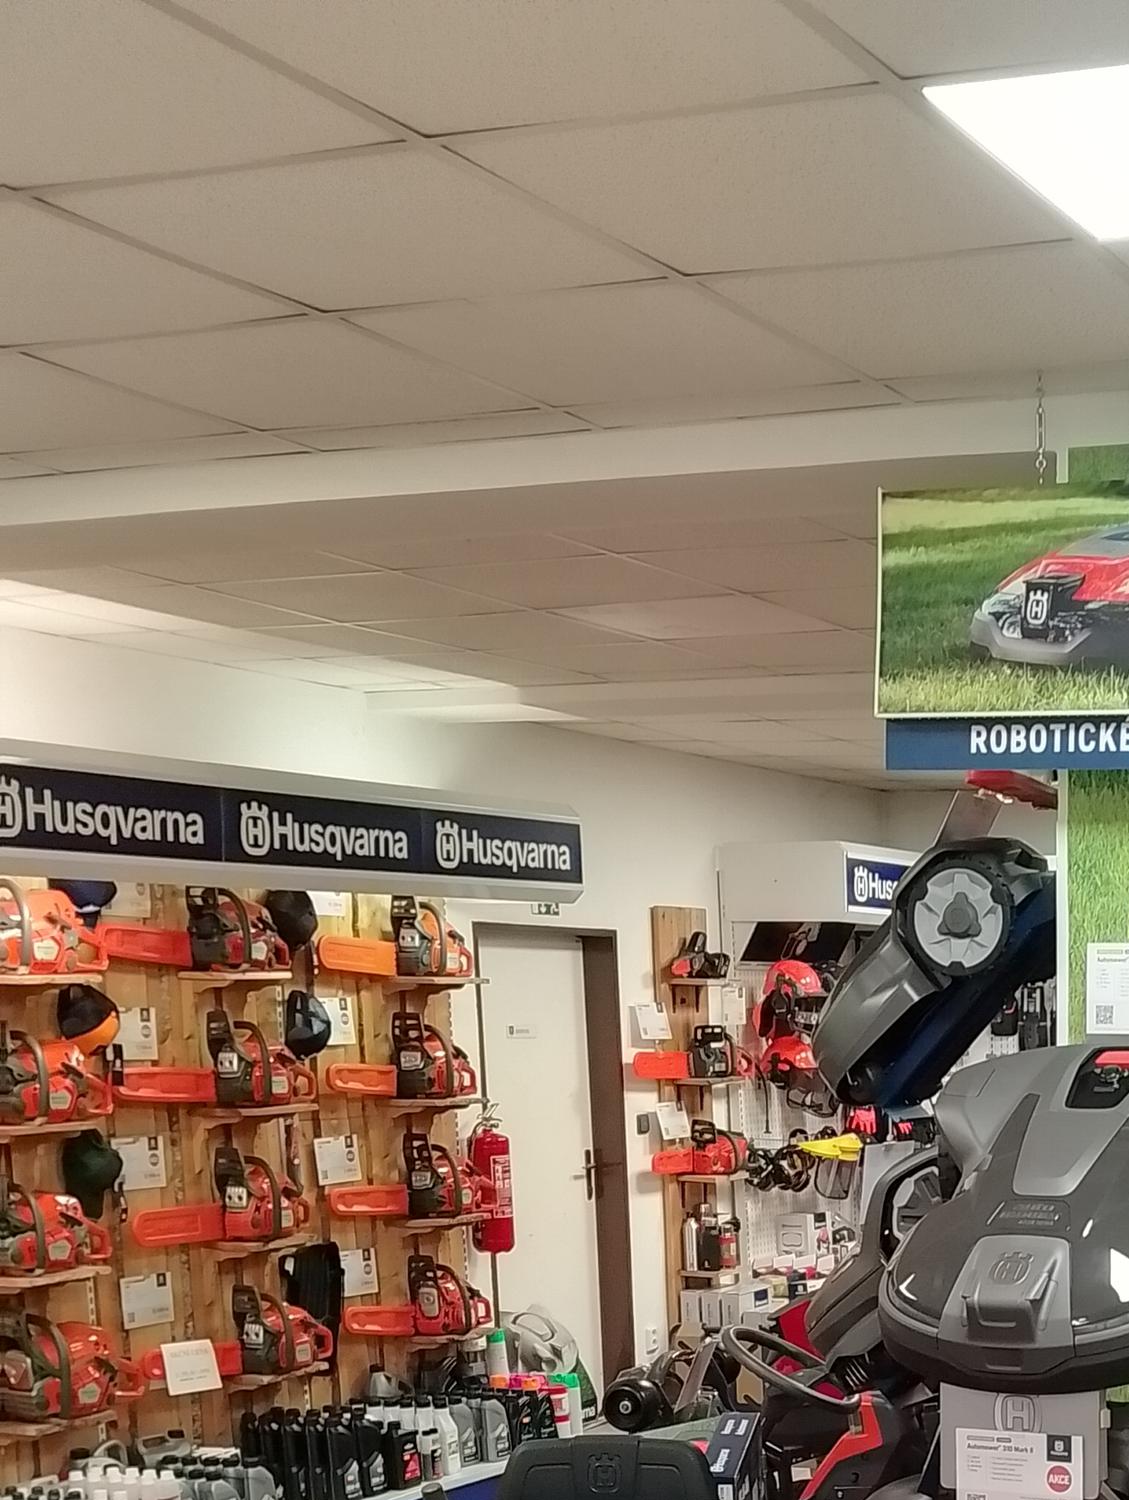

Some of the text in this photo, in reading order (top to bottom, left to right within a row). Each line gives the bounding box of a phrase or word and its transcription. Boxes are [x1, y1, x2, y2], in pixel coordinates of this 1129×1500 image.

[27, 787, 204, 845] Husqvarna
[273, 811, 408, 861] Husqvarna
[462, 830, 571, 874] Husqvarna
[1048, 1473, 1070, 1486] AKCE
